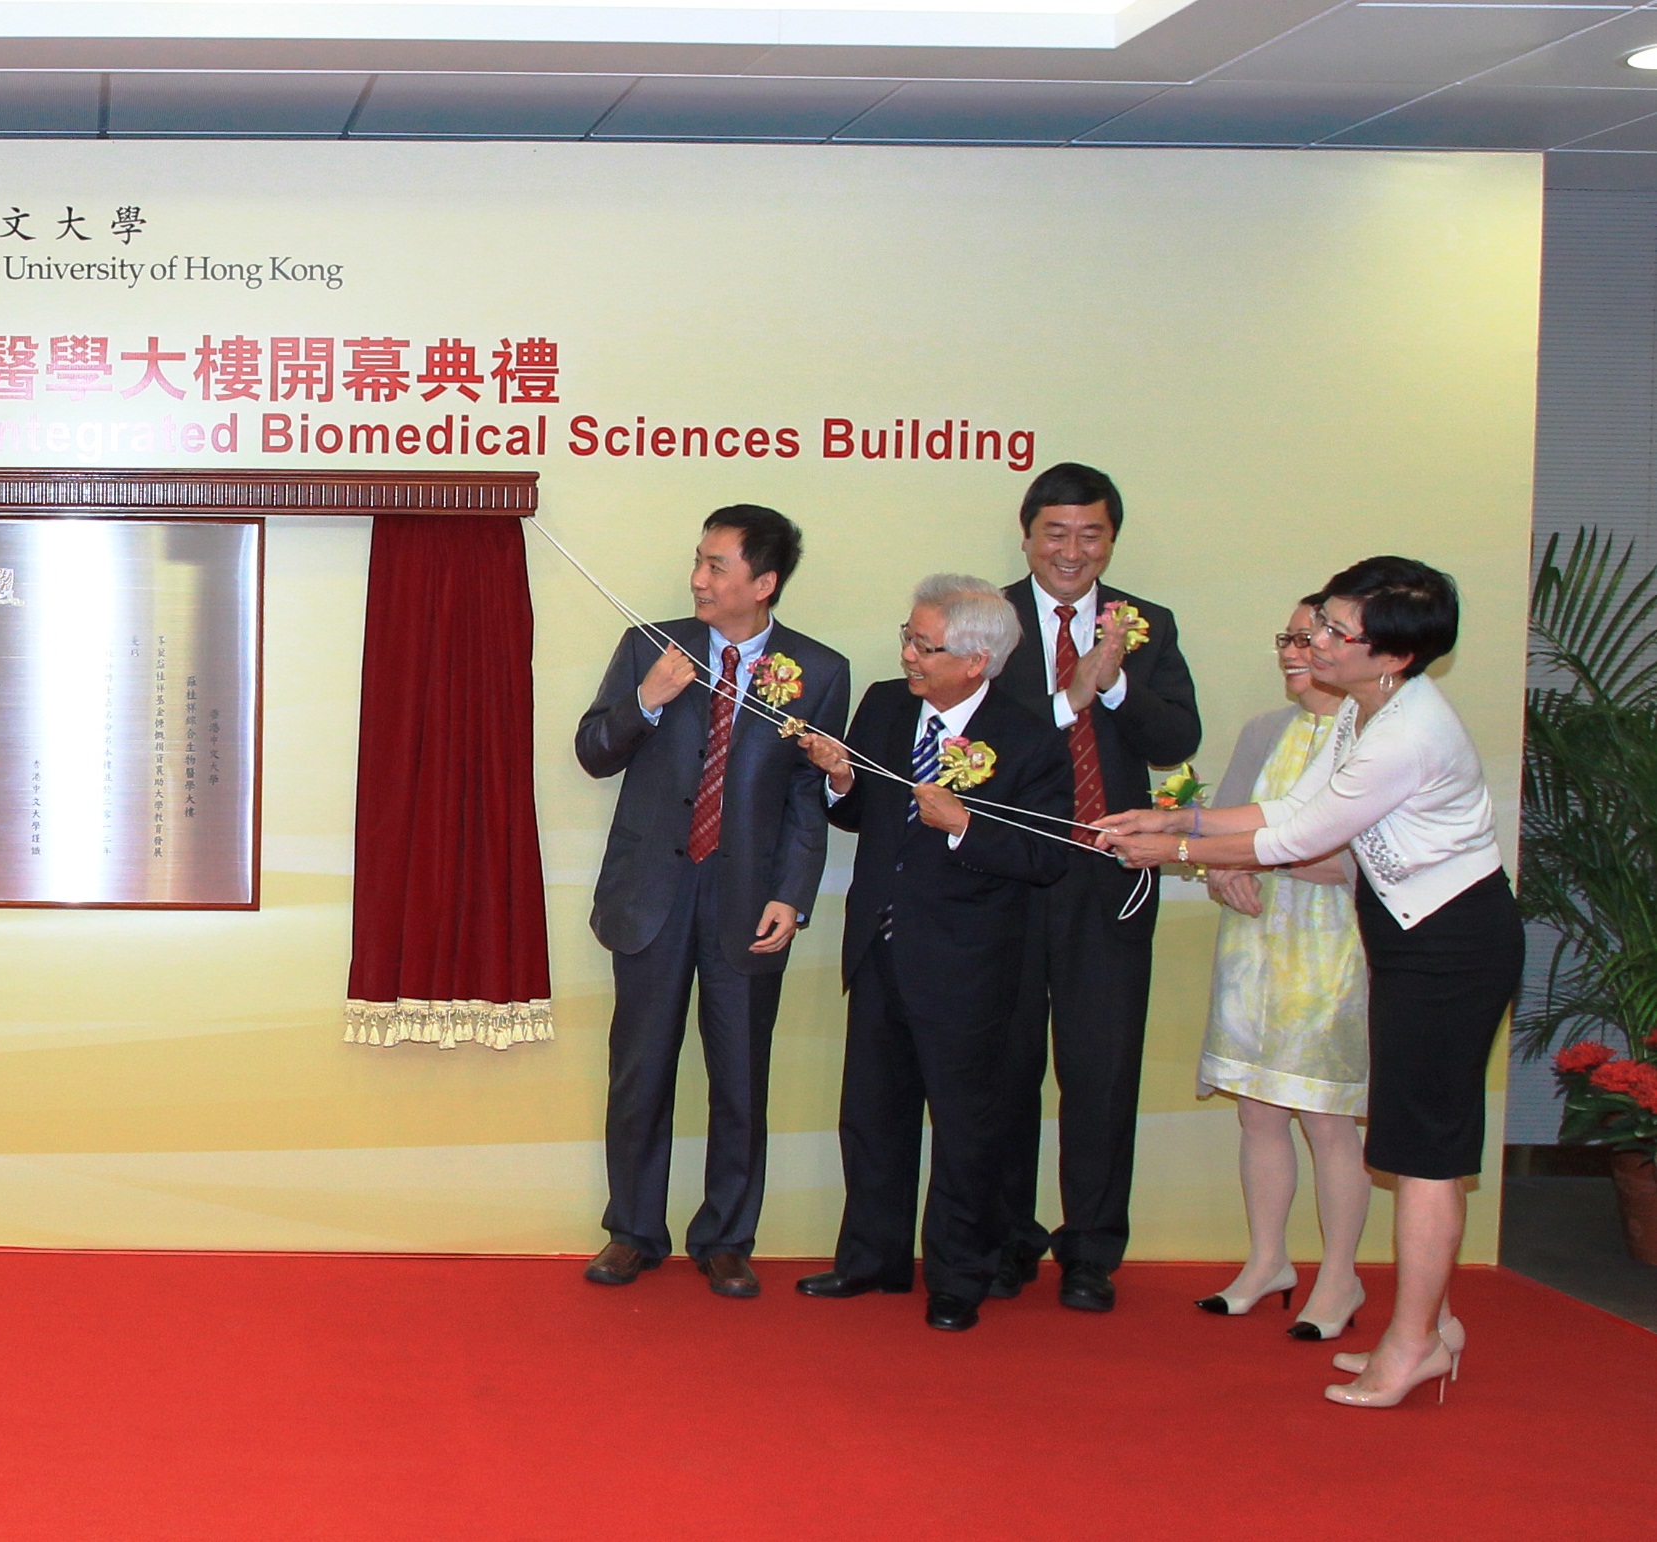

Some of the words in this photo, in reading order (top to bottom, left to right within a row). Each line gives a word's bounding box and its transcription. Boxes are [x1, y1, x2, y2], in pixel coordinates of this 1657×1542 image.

[2, 254, 146, 289] University
[150, 254, 180, 281] of
[184, 256, 263, 290] Hong
[268, 256, 344, 290] Kong
[261, 412, 547, 457] Biomedical
[568, 414, 802, 459] Sciences
[822, 417, 1037, 472] Building
[184, 674, 197, 818] 羅桂祥綜合生物醫學大樓
[207, 707, 220, 786] 香港中文大學
